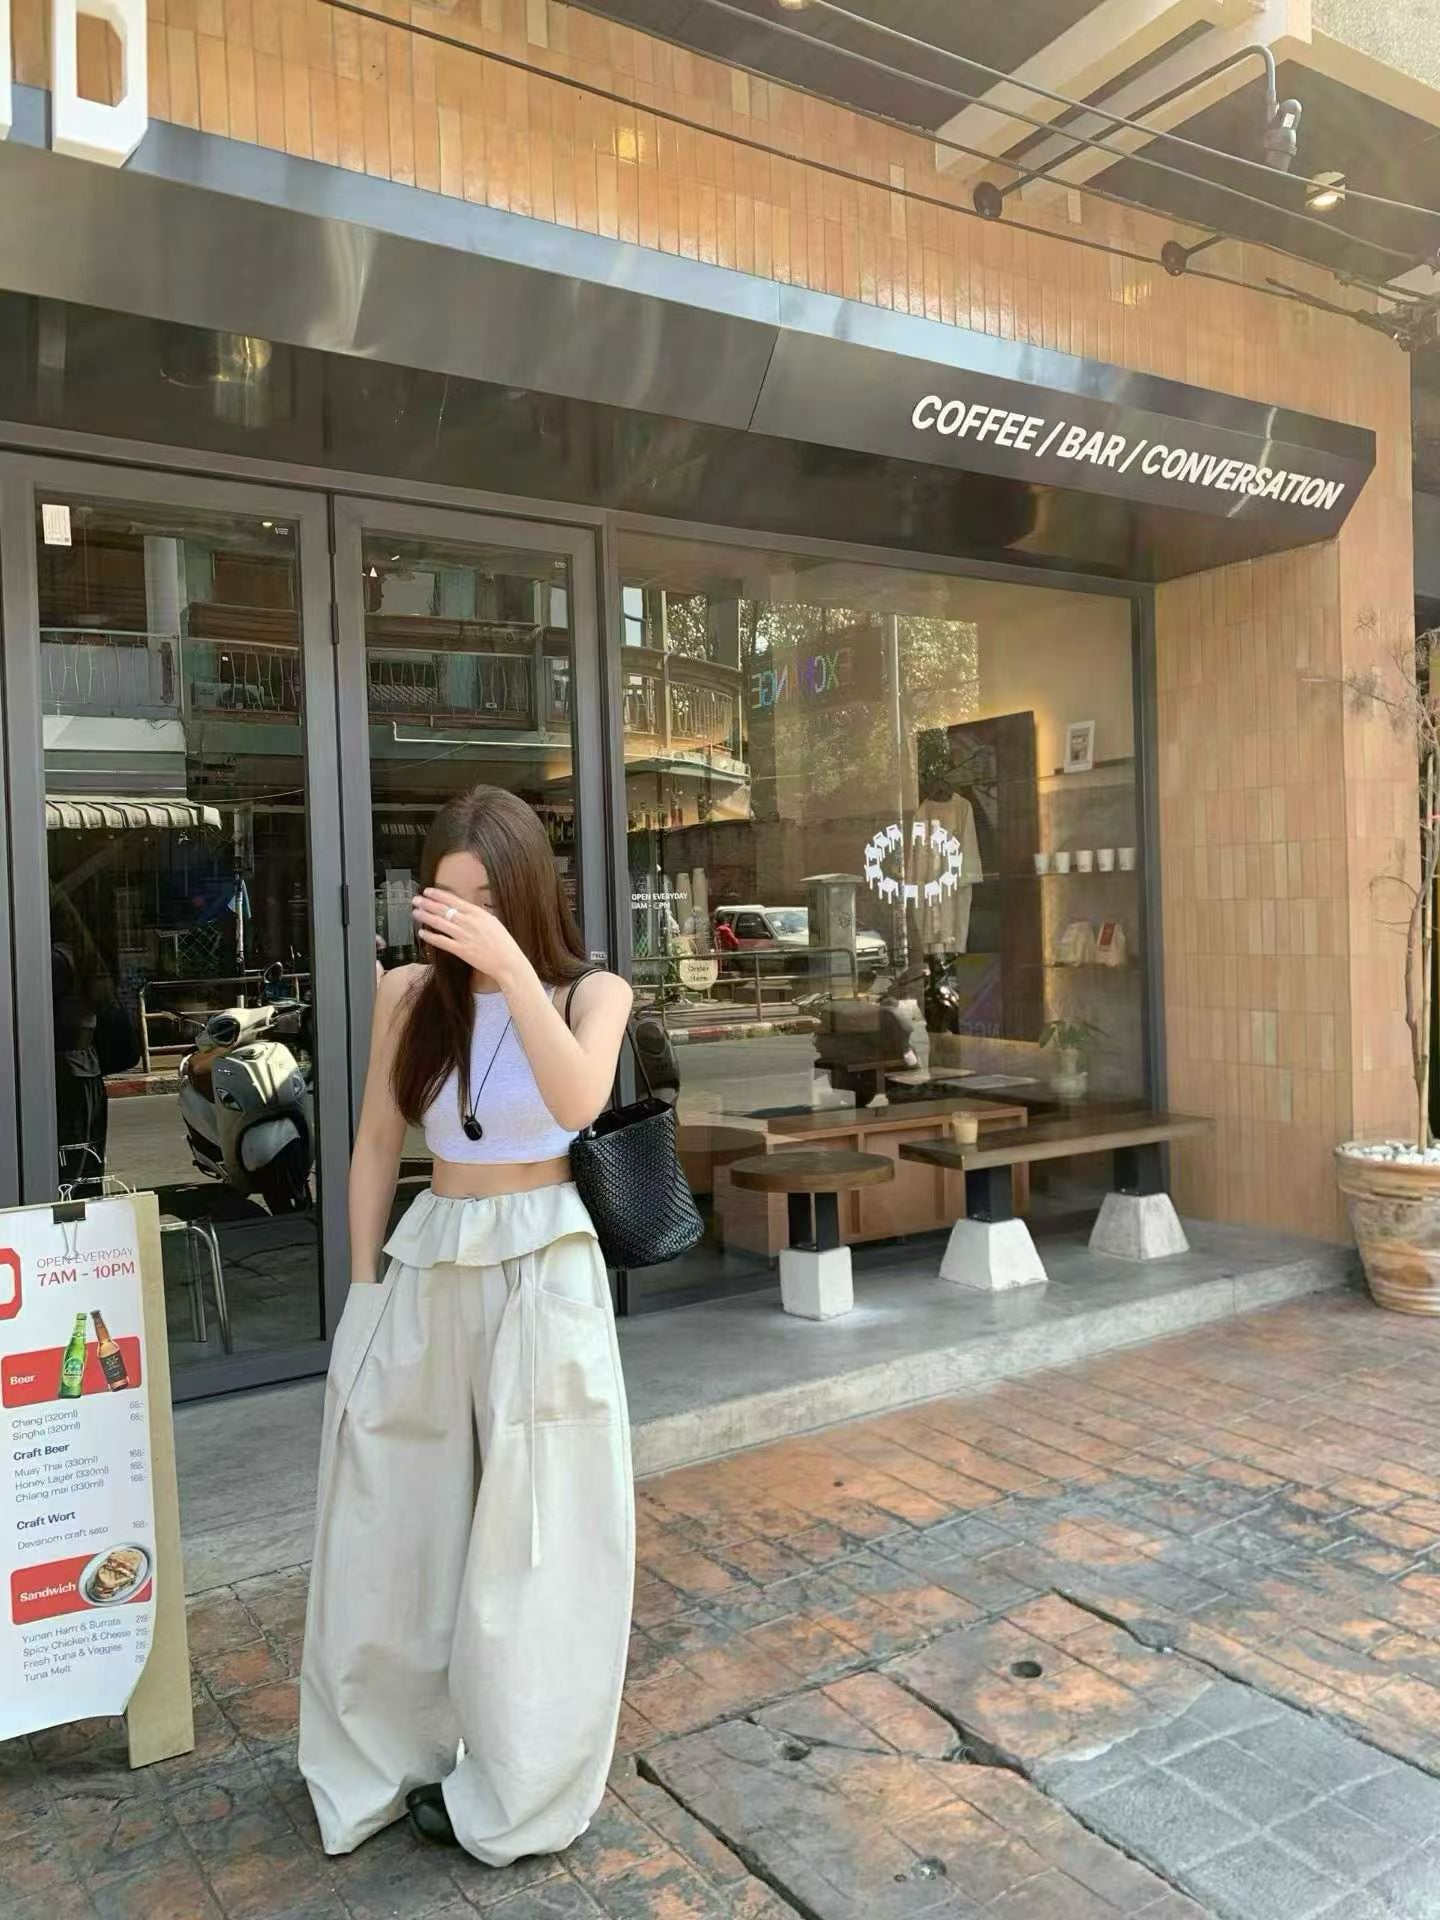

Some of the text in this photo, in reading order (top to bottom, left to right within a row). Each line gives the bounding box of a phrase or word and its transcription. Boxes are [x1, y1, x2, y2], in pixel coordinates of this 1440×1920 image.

[911, 395, 1045, 450] COFFEE
[1055, 426, 1130, 468] BAR
[1142, 444, 1345, 511] CONVERSATION
[631, 892, 688, 901] OPEN EVERYDAY
[36, 1247, 134, 1269] OPEN EVERYDAY
[37, 1268, 77, 1287] 7AM
[93, 1260, 136, 1280] 10PM
[10, 1374, 36, 1386] Beer
[11, 1416, 43, 1429] Chang
[12, 1427, 46, 1441] Singha
[13, 1443, 70, 1461] Craft Beer
[15, 1490, 49, 1503] Chiang
[16, 1511, 76, 1530] Craft Wort
[64, 1529, 87, 1540] craft
[19, 1582, 77, 1602] Sandwich
[22, 1630, 52, 1644] Yunan
[55, 1624, 79, 1637] Ham
[80, 1623, 87, 1632] &
[23, 1645, 49, 1658] Spicy
[51, 1634, 90, 1651] Chicken
[91, 1633, 98, 1641] &
[23, 1656, 50, 1670] Fresh
[53, 1651, 77, 1664] Tuna
[79, 1648, 86, 1657] &
[24, 1670, 48, 1683] Tuna
[50, 1664, 72, 1677] Melt
